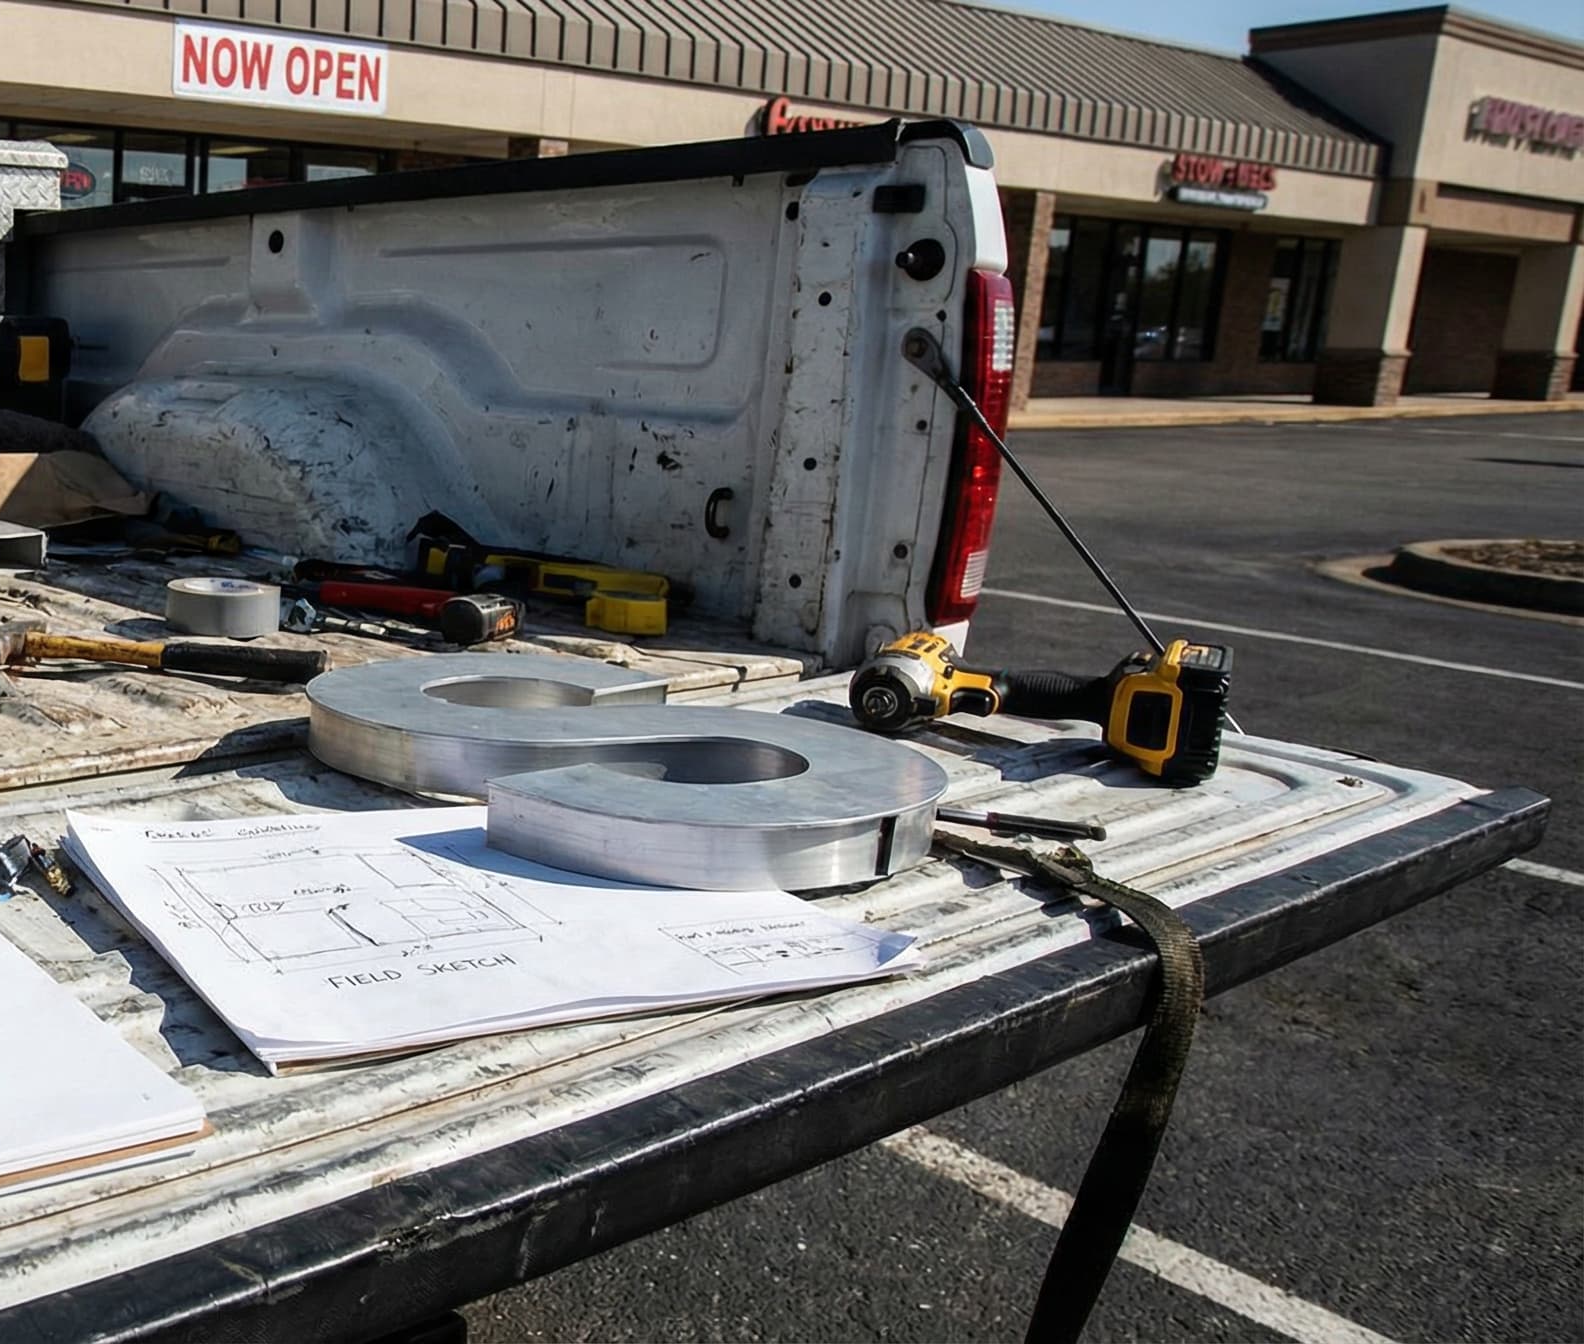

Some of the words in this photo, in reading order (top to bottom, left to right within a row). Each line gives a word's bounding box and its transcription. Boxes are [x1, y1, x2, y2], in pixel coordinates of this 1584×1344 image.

[182, 33, 274, 91] NOW
[285, 46, 381, 102] OPEN
[327, 969, 403, 990] FIELD
[416, 953, 518, 976] SKETCH
